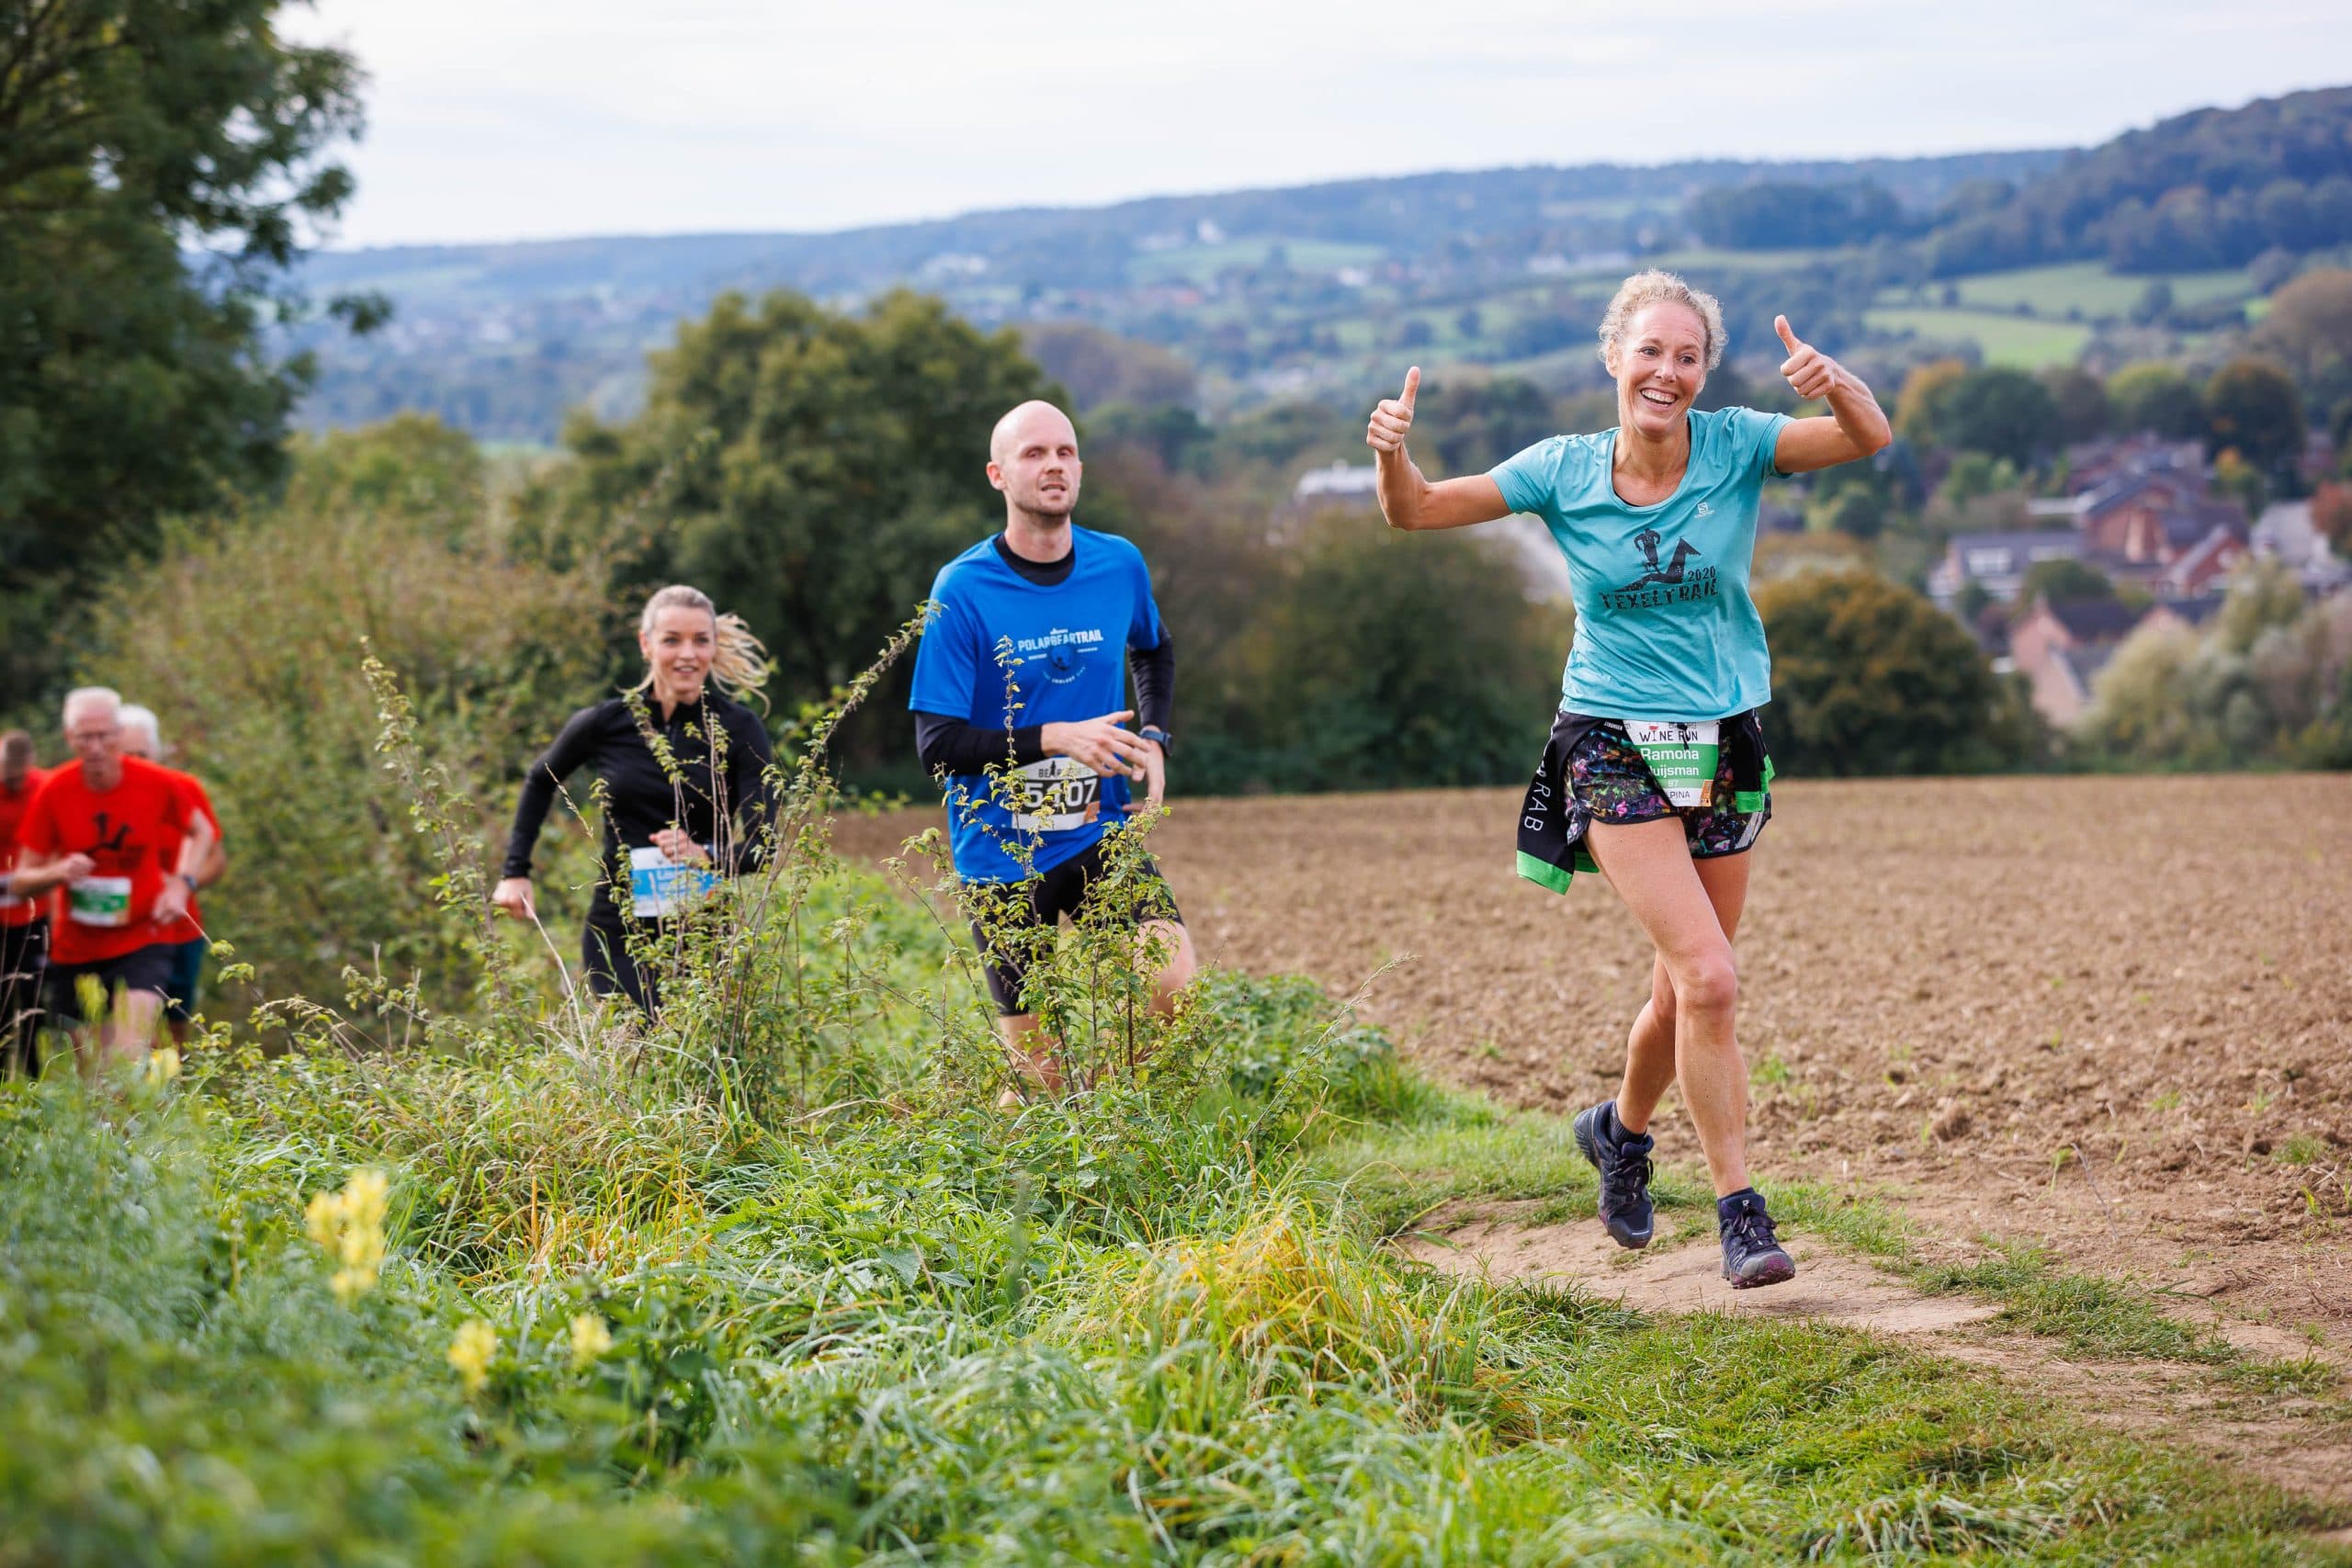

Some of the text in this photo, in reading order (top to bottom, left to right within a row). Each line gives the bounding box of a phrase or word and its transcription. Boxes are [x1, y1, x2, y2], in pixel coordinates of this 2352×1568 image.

[1688, 566, 1715, 581] 2020
[1639, 726, 1674, 741] WINE
[1678, 730, 1698, 741] RUN
[1640, 748, 1700, 761] Ramona
